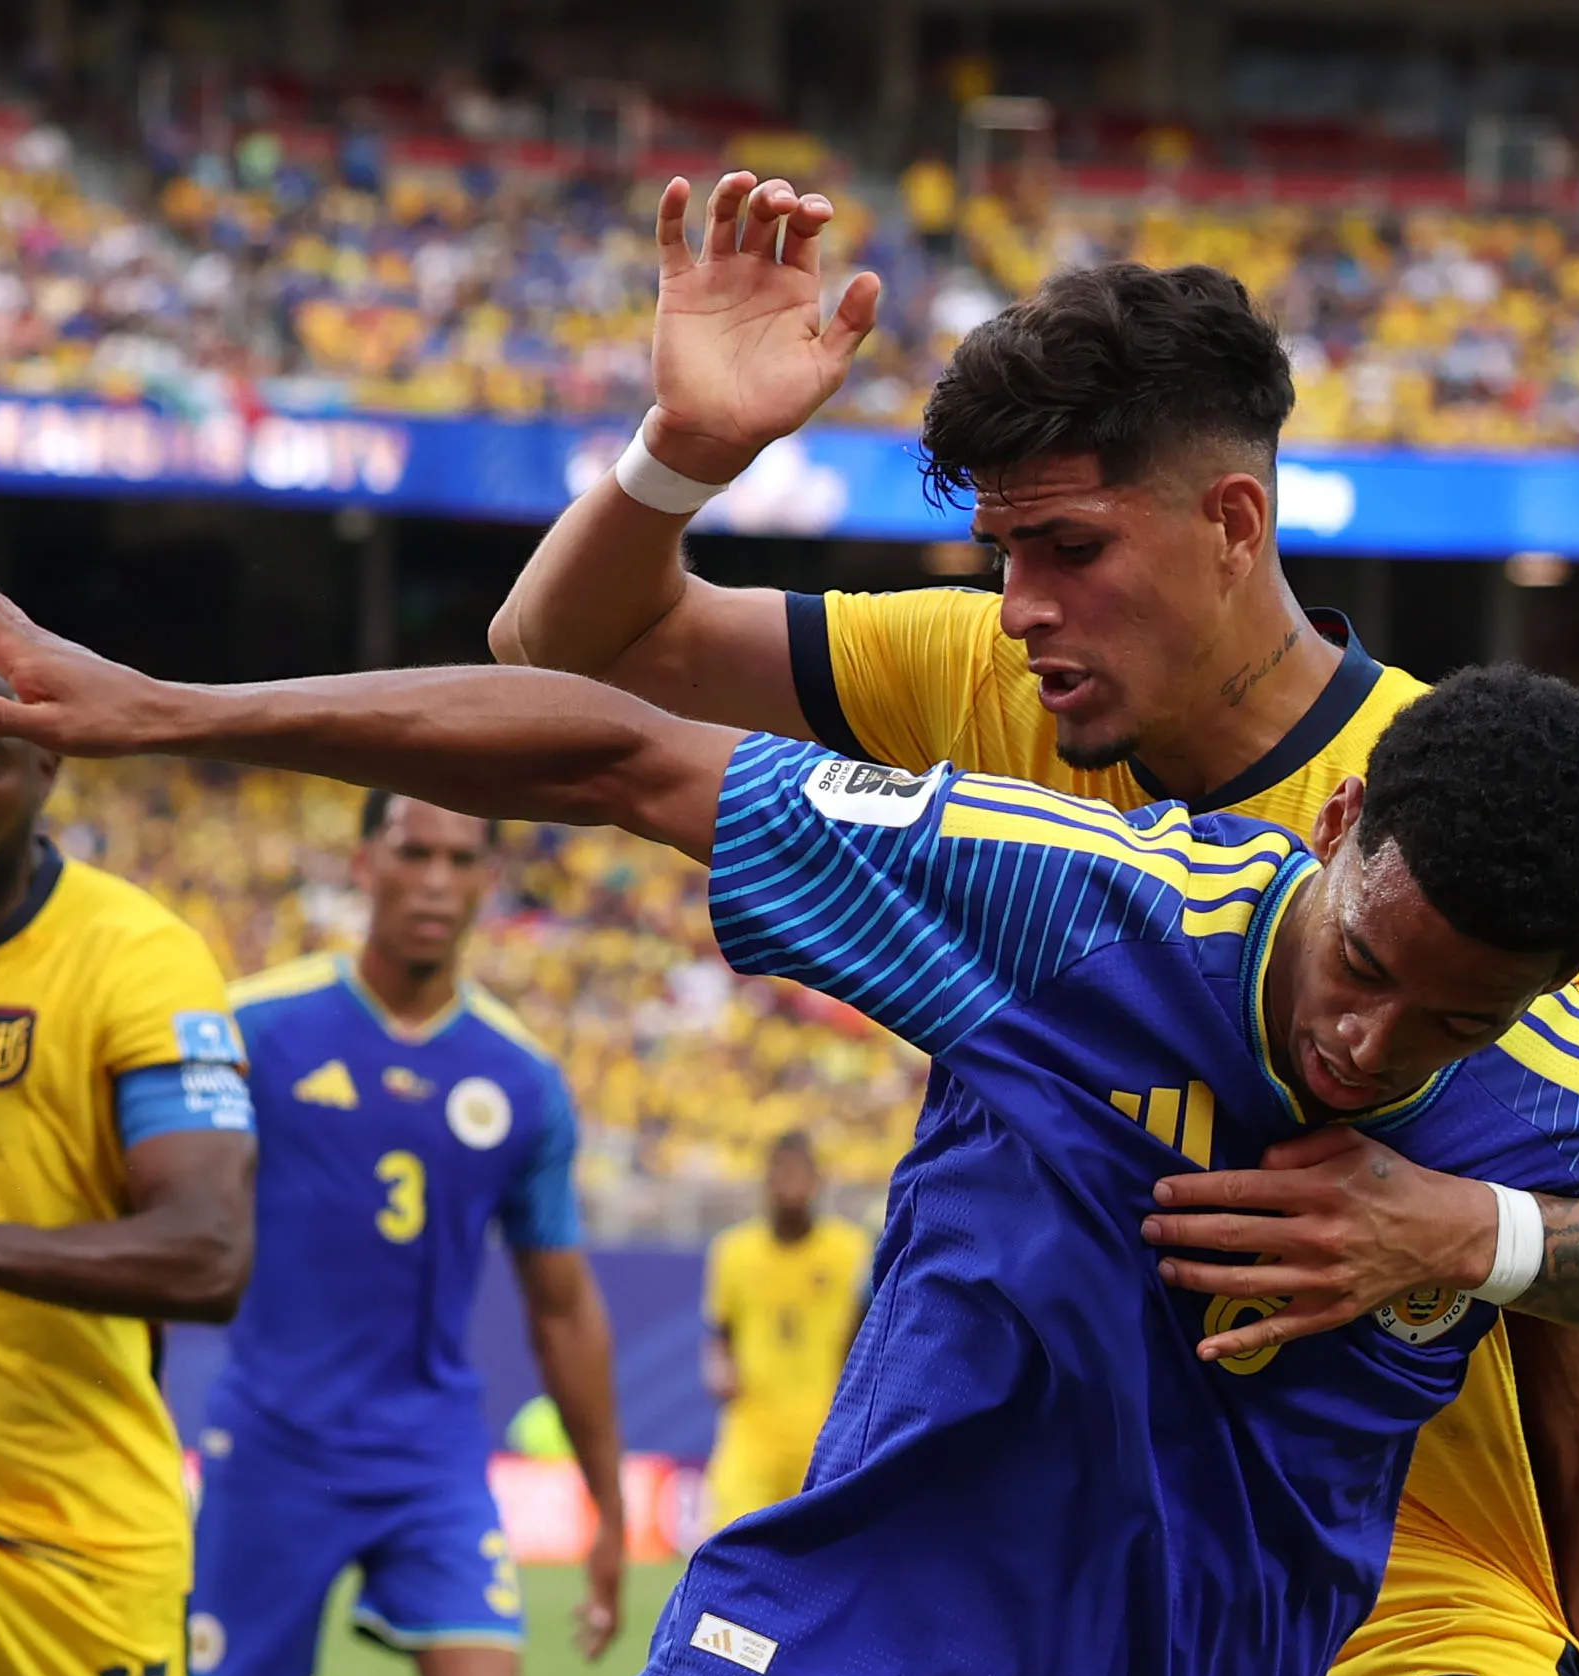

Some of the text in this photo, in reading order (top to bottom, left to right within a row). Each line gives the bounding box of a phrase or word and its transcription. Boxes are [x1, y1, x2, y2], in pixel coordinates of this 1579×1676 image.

[818, 760, 842, 792] 026
[374, 1147, 428, 1245] 3
[479, 1527, 522, 1618] 3
